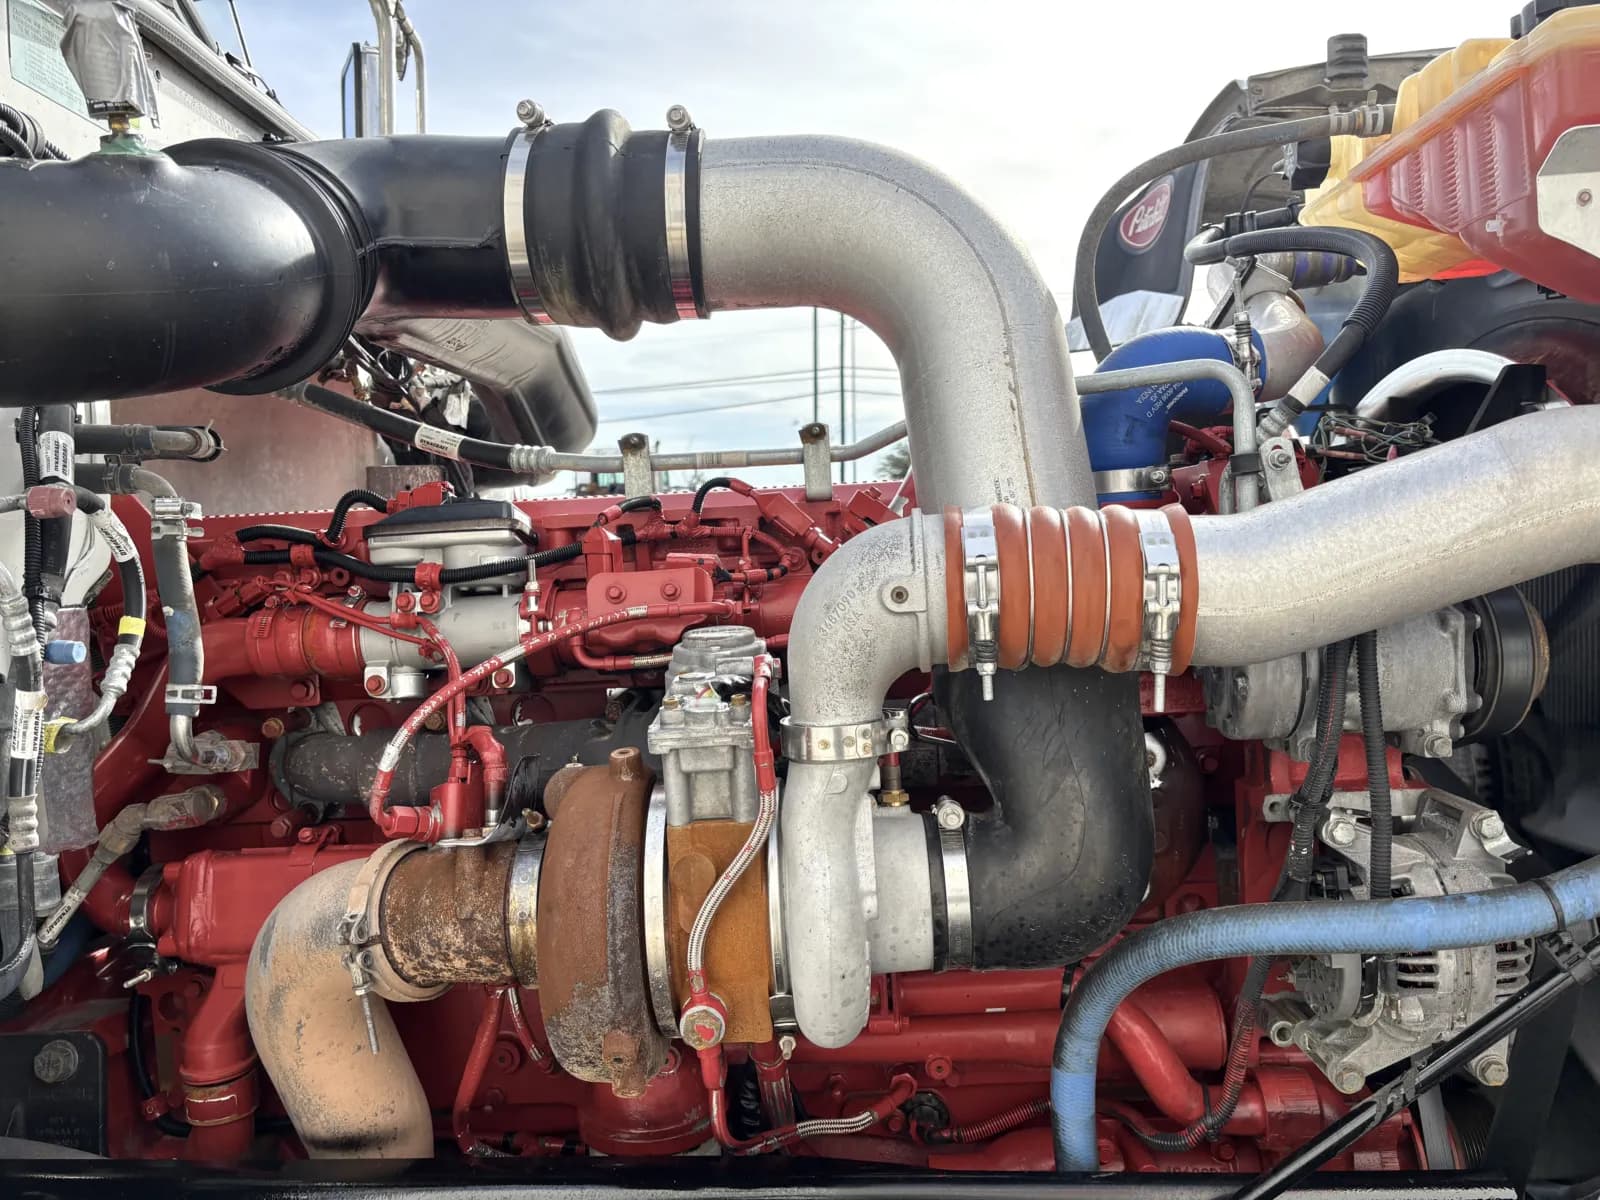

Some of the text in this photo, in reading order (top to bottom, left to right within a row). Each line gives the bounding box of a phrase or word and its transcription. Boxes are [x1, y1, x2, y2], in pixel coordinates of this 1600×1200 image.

[420, 439, 448, 451] DYNACRAFT
[842, 610, 863, 631] USA
[46, 905, 71, 934] DYNACRAFT
